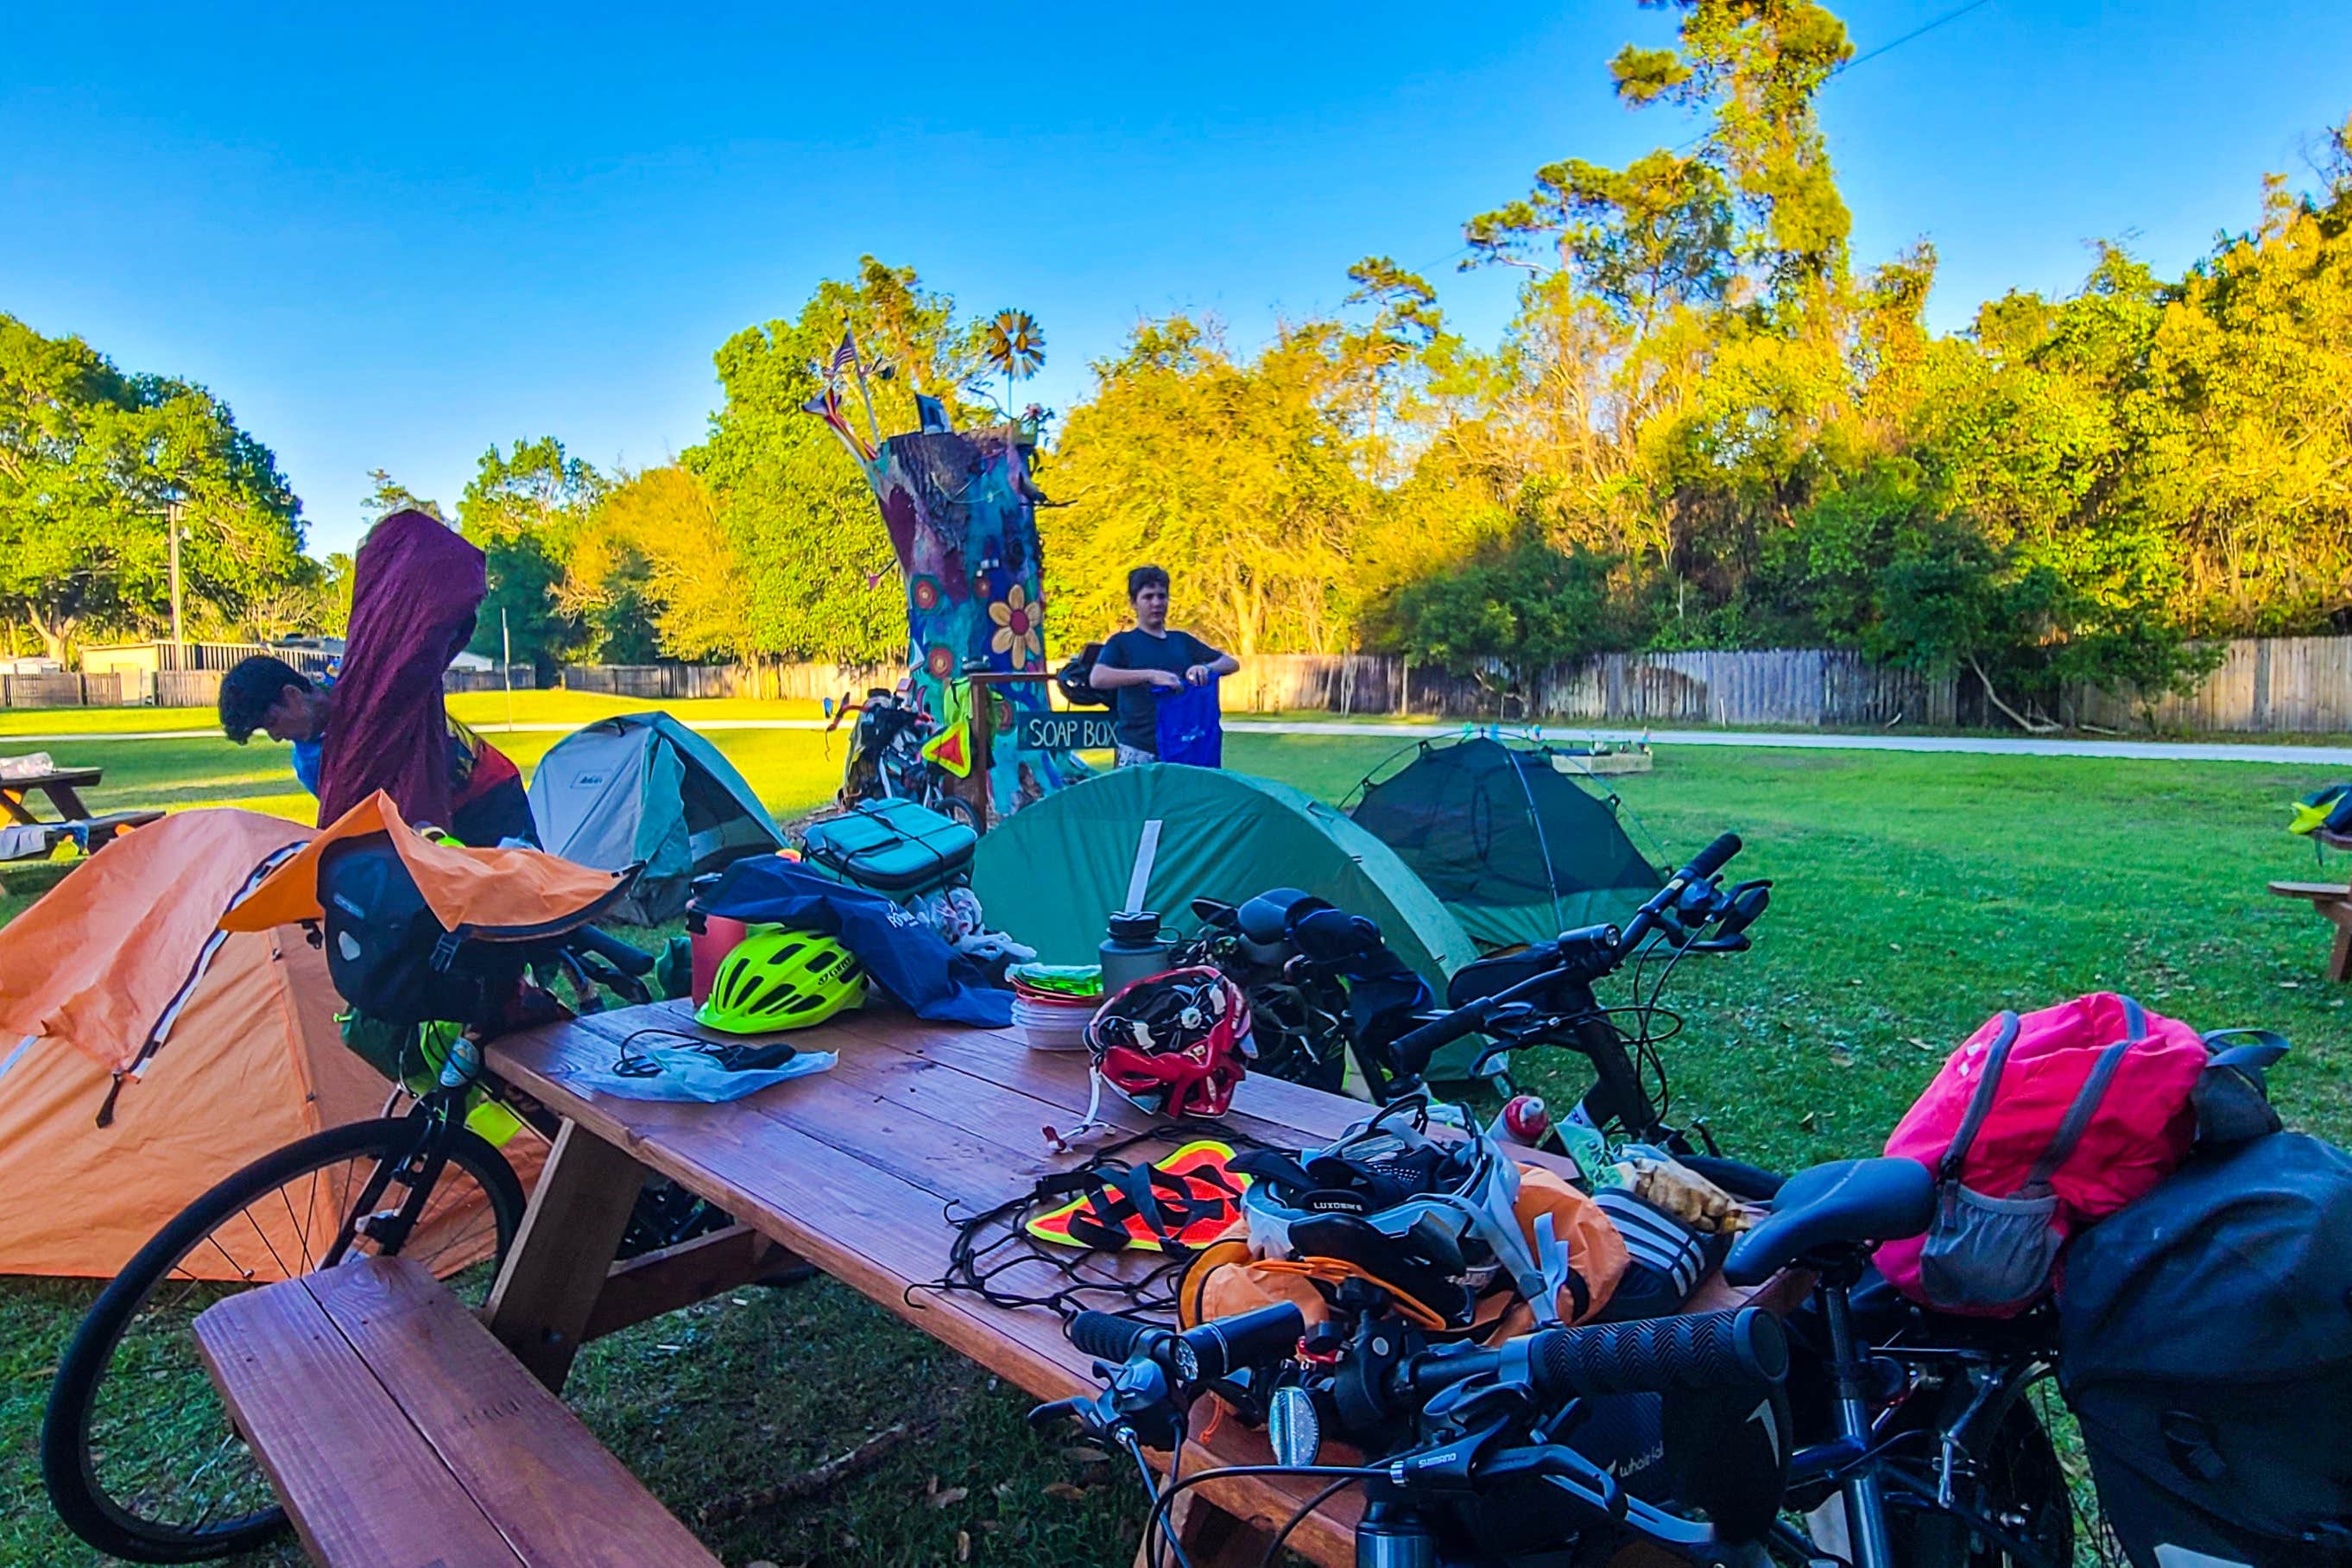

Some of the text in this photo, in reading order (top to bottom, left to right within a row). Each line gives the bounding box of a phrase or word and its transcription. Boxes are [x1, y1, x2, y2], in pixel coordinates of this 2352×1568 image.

[1029, 718, 1120, 748] SOAP BOX
[1418, 1452, 1457, 1469] SHIMANO
